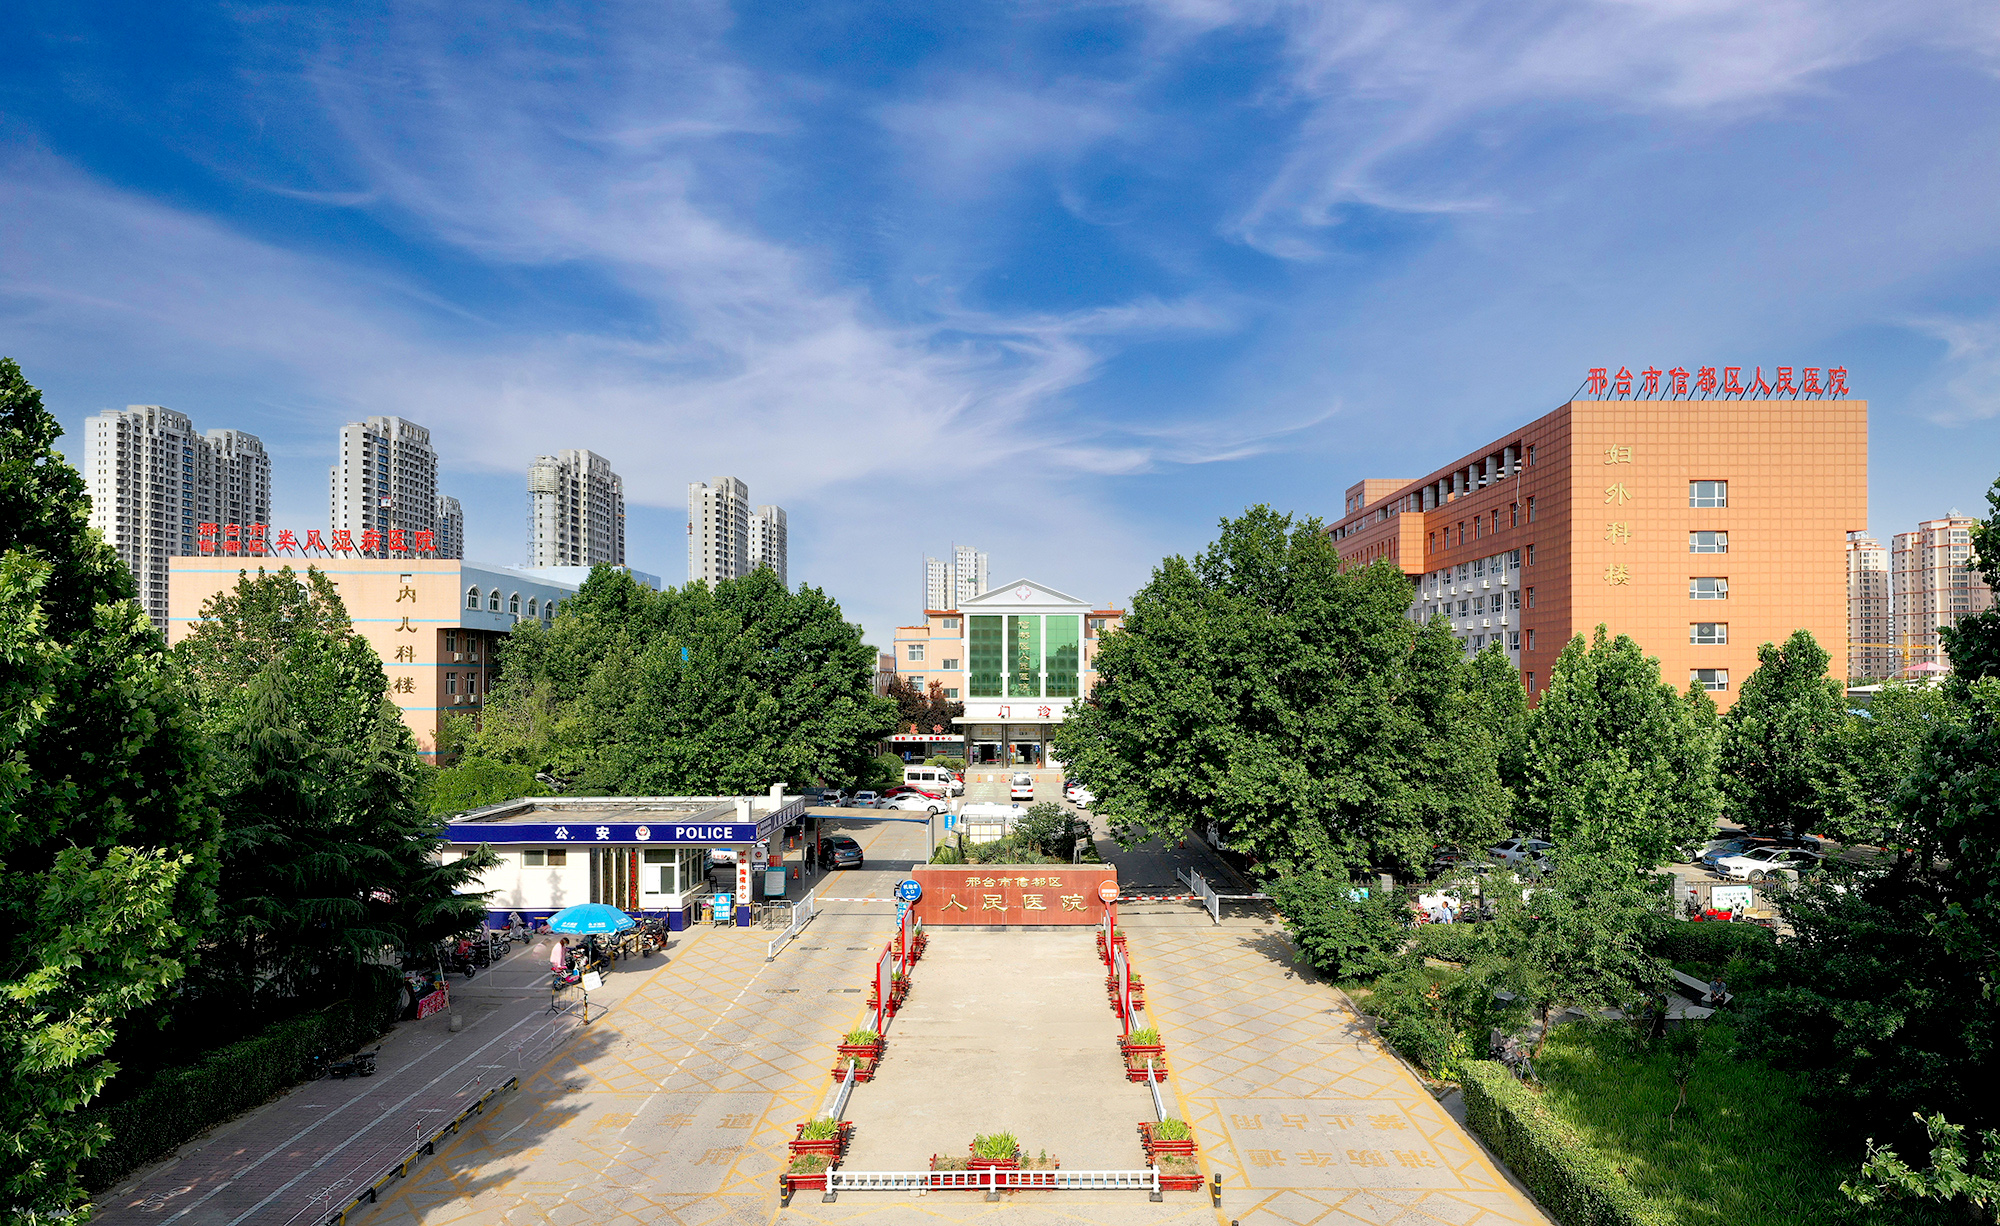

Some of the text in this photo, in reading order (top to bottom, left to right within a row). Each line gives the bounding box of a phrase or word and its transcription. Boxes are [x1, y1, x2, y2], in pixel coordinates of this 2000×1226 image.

[1587, 366, 1849, 395] 邢台市信都区人民医院
[1603, 443, 1633, 586] 妇外科楼
[197, 522, 269, 537] 邢台市
[197, 539, 269, 553] 信都区
[275, 528, 437, 552] 类风湿病医院
[394, 585, 417, 695] 内儿科楼
[998, 705, 1051, 718] 门诊
[555, 826, 610, 840] 公安
[676, 827, 733, 839] POLICE
[965, 876, 1063, 888] 邢台市信都区
[941, 893, 1088, 912] 人民医院
[1230, 1113, 1409, 1131] 禁止占用
[1244, 1148, 1437, 1169] 消防车道
